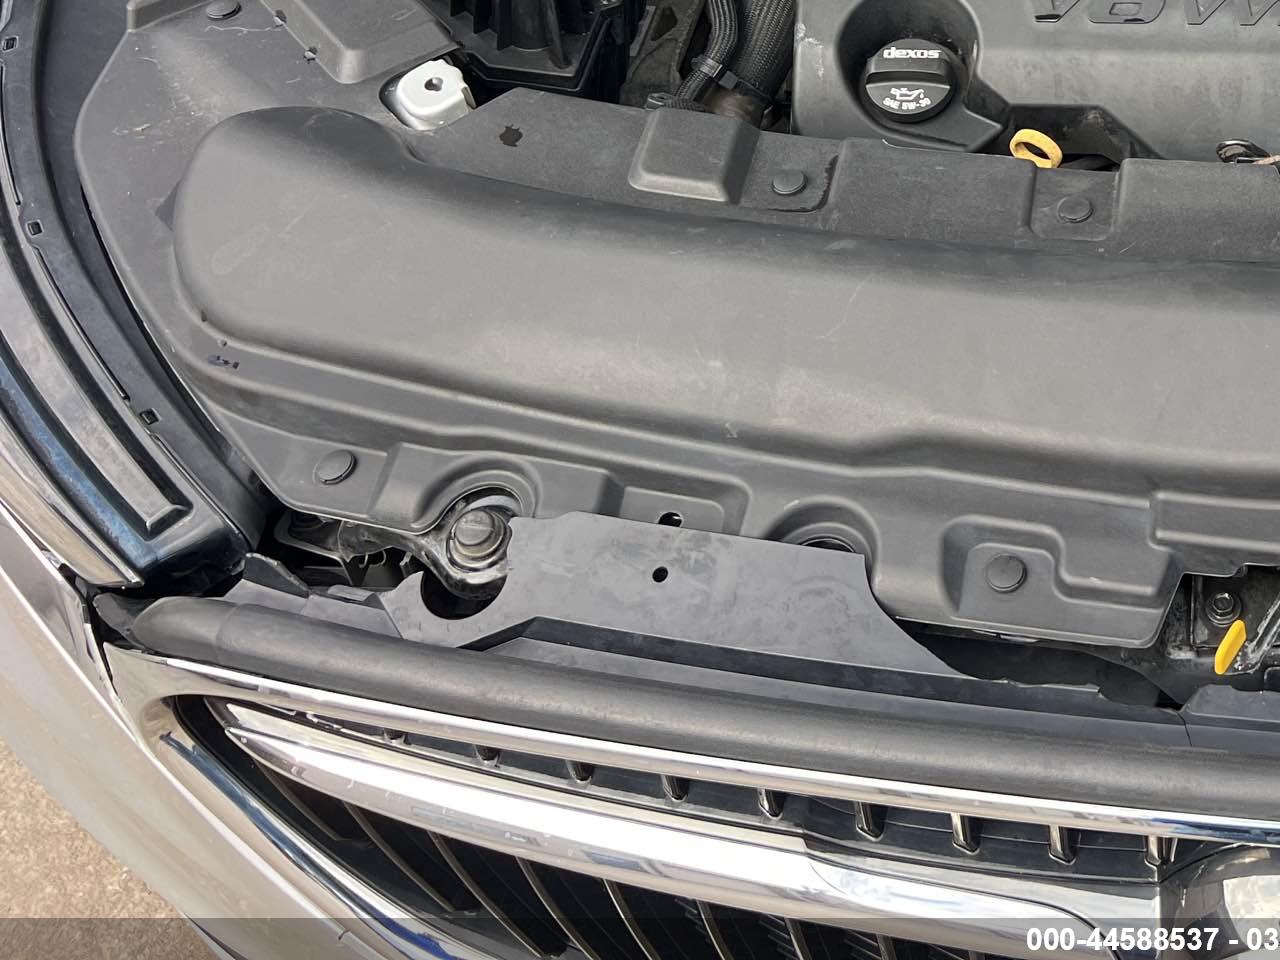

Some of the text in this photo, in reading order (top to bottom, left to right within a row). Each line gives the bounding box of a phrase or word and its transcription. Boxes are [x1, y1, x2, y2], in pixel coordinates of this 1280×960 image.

[882, 46, 942, 59] dexos
[882, 97, 931, 110] SAE 5W-30
